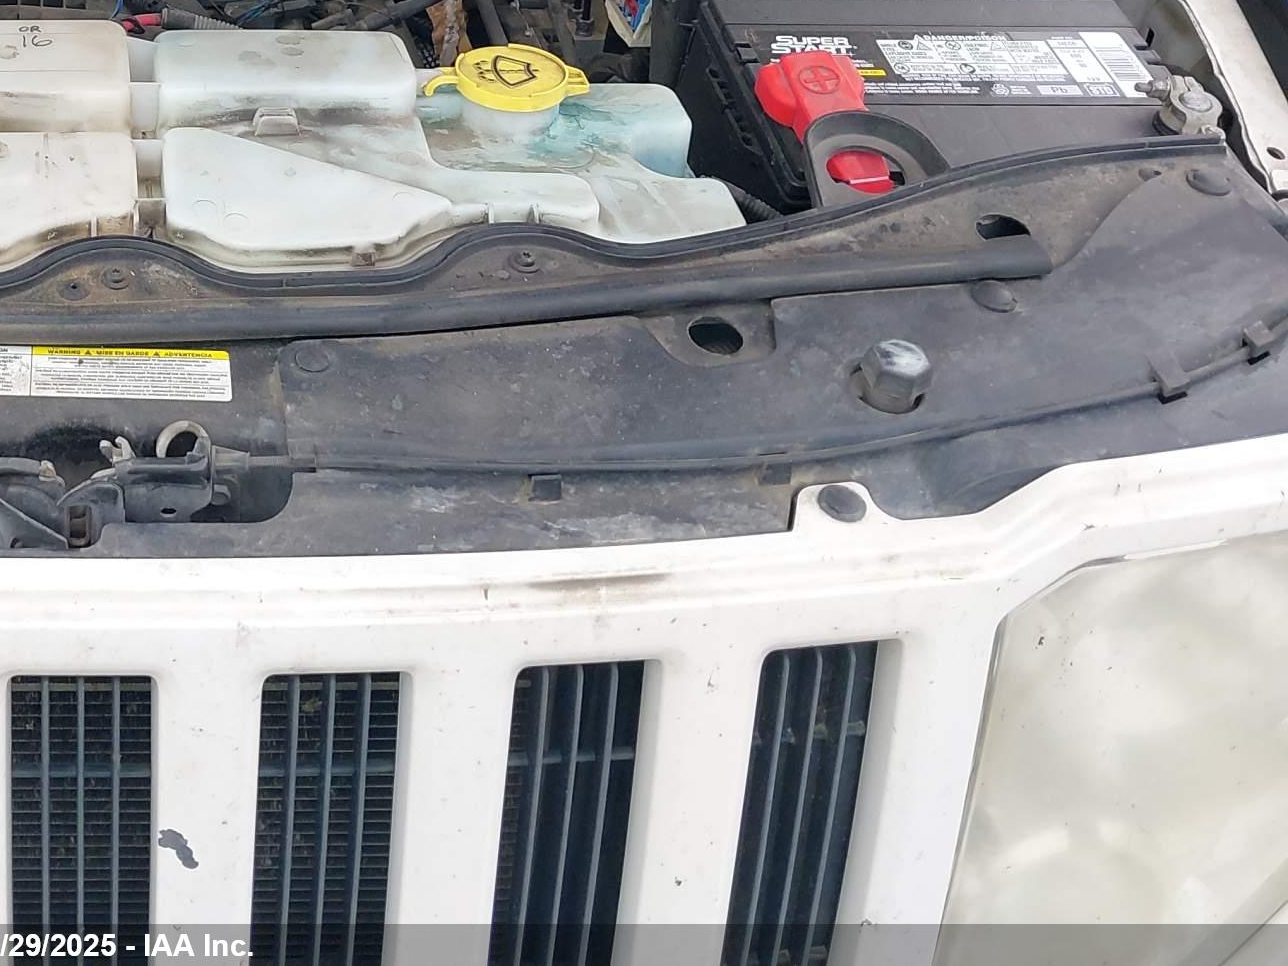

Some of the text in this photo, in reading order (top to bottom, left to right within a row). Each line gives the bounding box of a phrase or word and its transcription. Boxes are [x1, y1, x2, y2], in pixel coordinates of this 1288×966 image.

[18, 25, 42, 33] OR
[20, 34, 53, 49] 16
[775, 35, 850, 46] SUPER
